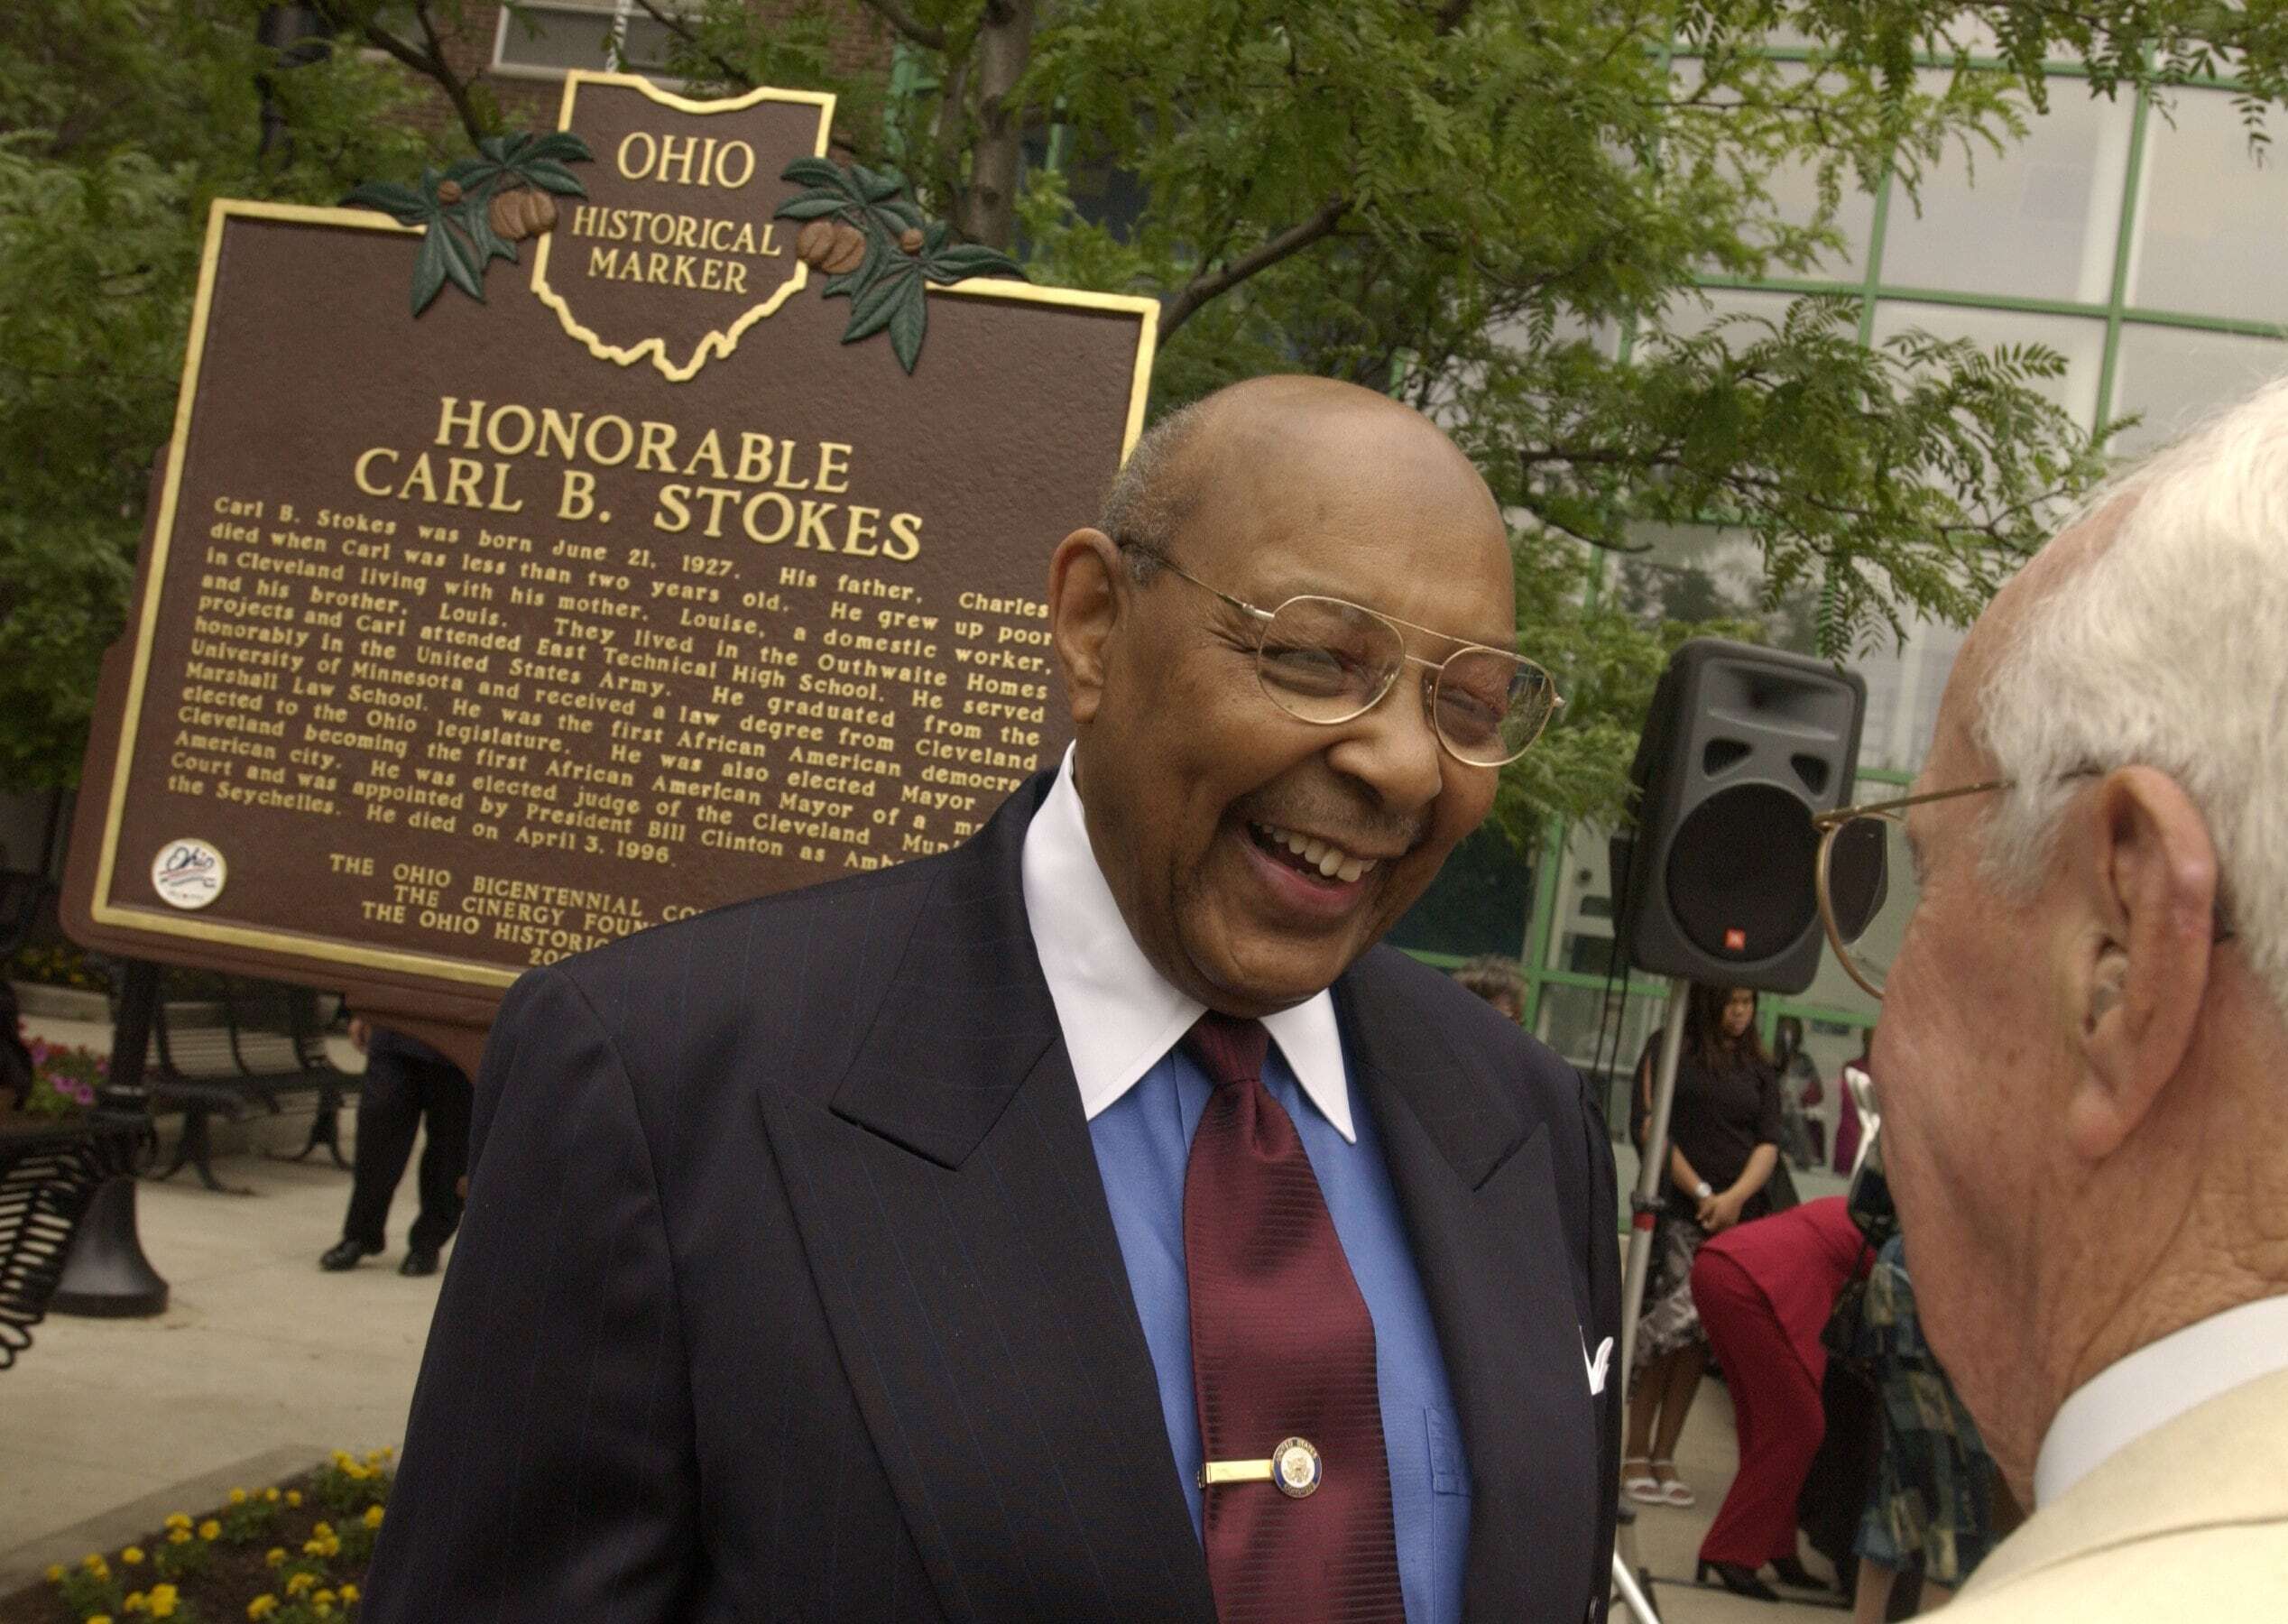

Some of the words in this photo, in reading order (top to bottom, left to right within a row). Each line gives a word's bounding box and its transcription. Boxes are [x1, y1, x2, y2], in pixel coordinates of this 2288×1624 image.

[617, 132, 756, 189] OHIO
[571, 205, 782, 257] HISTORICAL
[587, 246, 748, 294] MARKER
[434, 397, 853, 494] HONORABLE
[213, 495, 264, 519] Carl
[316, 508, 398, 536] Stokes
[417, 524, 460, 544] was
[477, 528, 533, 553] born
[551, 539, 608, 562] June
[779, 566, 818, 588] His
[958, 591, 1050, 619] Charles
[355, 448, 524, 512] CARL
[557, 469, 612, 522] B.
[653, 483, 923, 561] STOKES
[200, 574, 242, 593] and
[256, 578, 290, 599] his
[553, 616, 616, 645] They
[633, 628, 695, 654] lived
[715, 638, 739, 660] in
[760, 645, 799, 667] the
[816, 652, 948, 687] Outhwaite
[965, 671, 1048, 701] Homes
[206, 546, 228, 567] in
[235, 550, 345, 582] Cleveland
[360, 567, 429, 597] living
[444, 579, 494, 601] with
[510, 586, 545, 607] his
[792, 626, 807, 642] a
[822, 628, 938, 659] domestic
[209, 521, 260, 544] died
[270, 531, 328, 553] when
[341, 539, 392, 561] Carl
[403, 549, 447, 568] was
[461, 552, 507, 576] less
[520, 561, 572, 585] than
[587, 569, 631, 591] two
[650, 580, 720, 604] years
[829, 600, 863, 623] He
[877, 609, 940, 632] grew
[954, 621, 984, 641] up
[997, 625, 1053, 647] poor
[190, 637, 305, 673] University
[316, 656, 342, 676] of
[351, 660, 464, 692] Minnesota
[477, 680, 521, 701] and
[534, 688, 636, 716] received
[651, 705, 666, 720] a
[678, 705, 721, 726] law
[739, 714, 824, 742] degree
[838, 726, 895, 752] from
[915, 737, 1038, 772] Cleveland
[194, 614, 309, 649] honorably
[320, 632, 344, 653] in
[360, 639, 397, 660] the
[416, 645, 490, 673] United
[508, 657, 581, 685] States
[711, 684, 744, 706] He
[766, 696, 896, 729] graduated
[923, 714, 983, 740] from
[1000, 725, 1041, 747] the
[198, 595, 294, 622] projects
[303, 609, 343, 629] and
[355, 614, 407, 637] Carl
[420, 624, 522, 653] attended
[535, 637, 587, 661] East
[603, 646, 718, 680] Technical
[731, 663, 787, 689] High
[910, 688, 944, 710] He
[962, 699, 1046, 724] served
[177, 706, 286, 737] Cleveland
[303, 723, 409, 760] becoming
[427, 742, 463, 762] the
[475, 747, 528, 772] first
[545, 759, 634, 788] African
[650, 774, 761, 807] American
[778, 791, 854, 819] Mayor
[872, 807, 901, 826] of
[912, 814, 927, 831] a
[181, 685, 263, 712] elected
[275, 697, 299, 716] to
[313, 703, 348, 724] the
[366, 709, 418, 734] Ohio
[610, 743, 642, 765] He
[660, 753, 703, 773] was
[721, 760, 770, 782] also
[786, 769, 876, 798] elected
[900, 784, 977, 812] Mayor
[185, 660, 278, 691] Marshall
[291, 676, 336, 697] Law
[452, 697, 482, 718] He
[501, 707, 542, 727] was
[558, 713, 595, 734] the
[610, 719, 664, 744] first
[676, 729, 766, 759] African
[788, 745, 902, 778] American
[167, 774, 205, 796] the
[365, 802, 397, 824] He
[407, 810, 457, 834] died
[471, 822, 499, 841] on
[513, 826, 577, 851] April
[171, 751, 232, 777] Court
[246, 765, 286, 784] and
[297, 772, 337, 792] was
[351, 780, 465, 810] appointed
[479, 795, 509, 819] by
[526, 802, 633, 835] President
[647, 819, 687, 843] Bill
[700, 828, 784, 857] Clinton
[798, 844, 826, 863] as
[843, 850, 905, 872] Amb
[173, 729, 276, 761] American
[370, 759, 401, 780] He
[415, 768, 457, 788] was
[471, 774, 558, 801] elected
[573, 787, 641, 817] judge
[655, 799, 682, 818] of
[696, 804, 733, 826] the
[752, 812, 871, 846] Cleveland
[329, 853, 375, 877] THE
[392, 863, 451, 888] OHIO
[473, 875, 642, 918] BICENTENNIAL
[661, 905, 704, 923] CO
[362, 901, 405, 924] THE
[419, 910, 480, 936] OHIO
[393, 884, 440, 909] THE
[461, 897, 566, 927] CINERGY
[584, 912, 659, 937] FOUN
